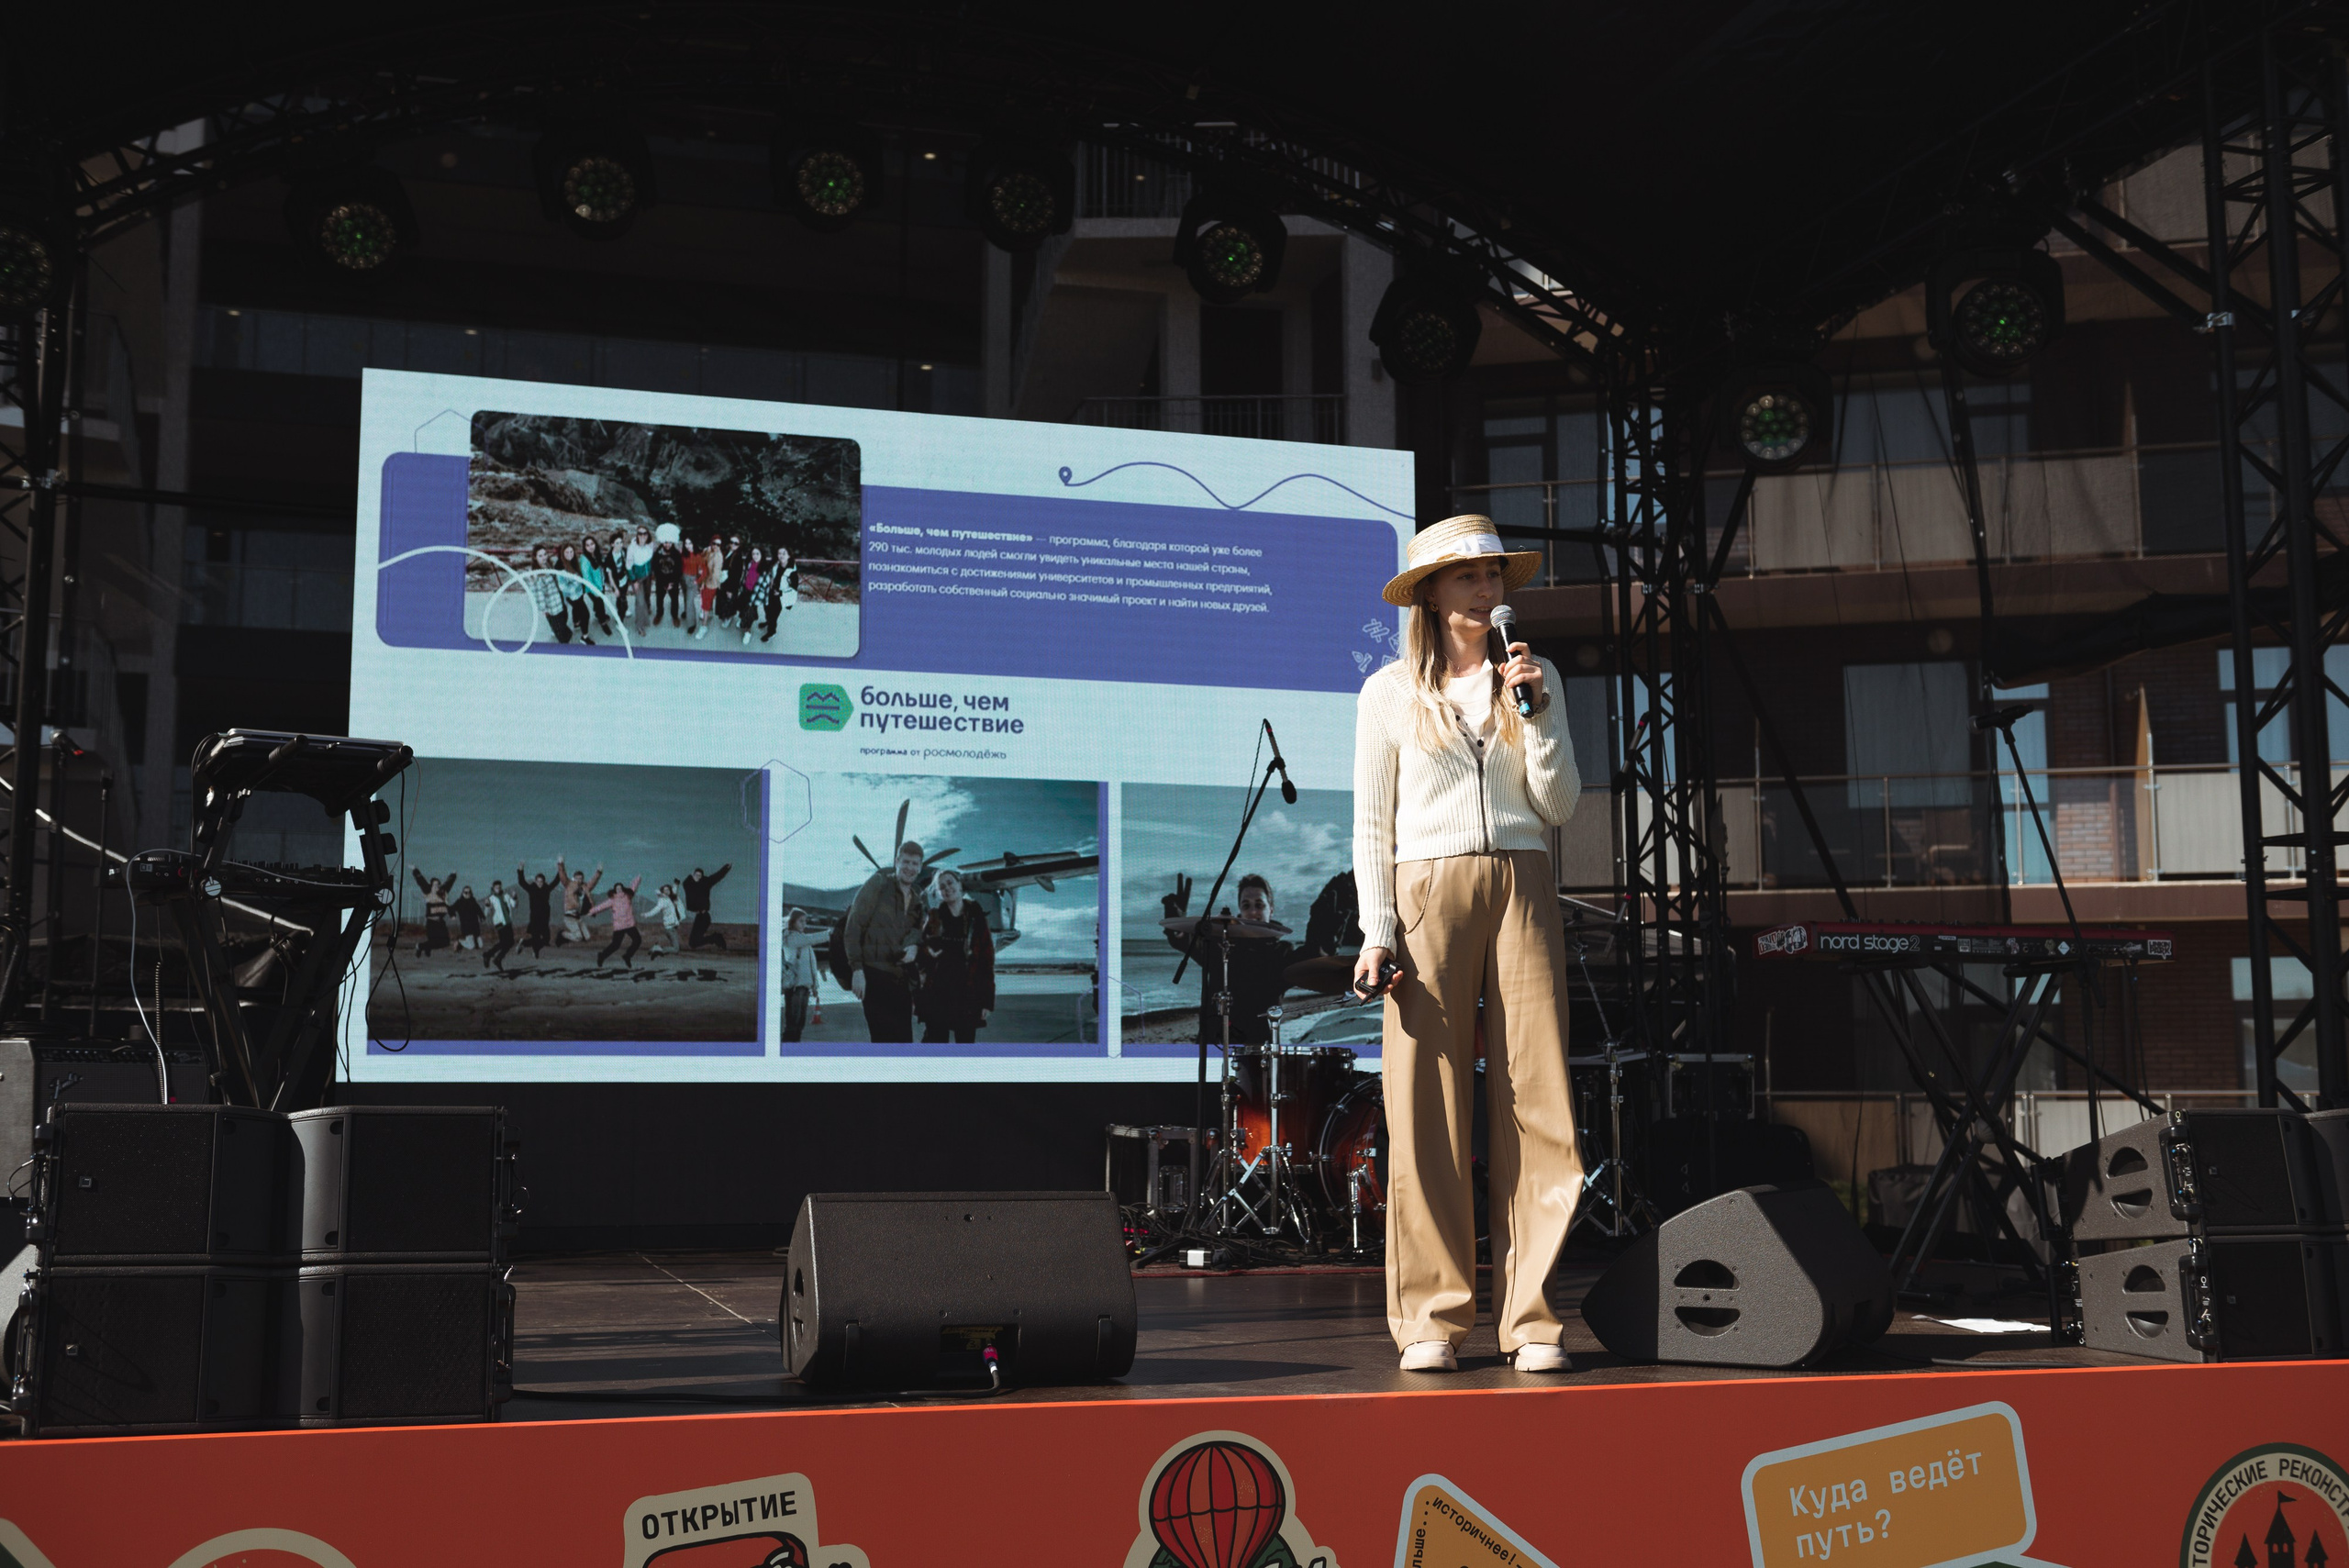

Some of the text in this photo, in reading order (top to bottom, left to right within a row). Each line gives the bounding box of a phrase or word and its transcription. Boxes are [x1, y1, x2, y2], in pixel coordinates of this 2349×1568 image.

[869, 522, 923, 538] «Больше,
[926, 528, 949, 537] чем
[952, 529, 1032, 542] путешествие»
[1050, 535, 1110, 548] программа,
[1113, 538, 1166, 551] благодаря
[1169, 543, 1209, 554] которой
[1211, 546, 1230, 556] уже
[1232, 545, 1263, 557] более
[869, 541, 1250, 576] 290 тыс. молодых людей смогли увидеть уникальные места нашей страны,
[868, 562, 1273, 596] познакомиться с достижениями университетов и промышленных предприятий,
[868, 581, 1270, 614] разработать собственный социально значимый проект и найти новых друзей.
[860, 685, 1009, 712] больше, чем
[860, 712, 1025, 735] путешествие
[860, 746, 907, 757] программа
[923, 748, 1007, 760] росмолодёжь
[1820, 934, 1860, 951] nord
[1789, 1449, 1982, 1519] Куда ведёт
[642, 1490, 797, 1540] ОТКРЫТИЕ
[1431, 1496, 1517, 1565] историчнее!
[1796, 1508, 1891, 1561] путь?
